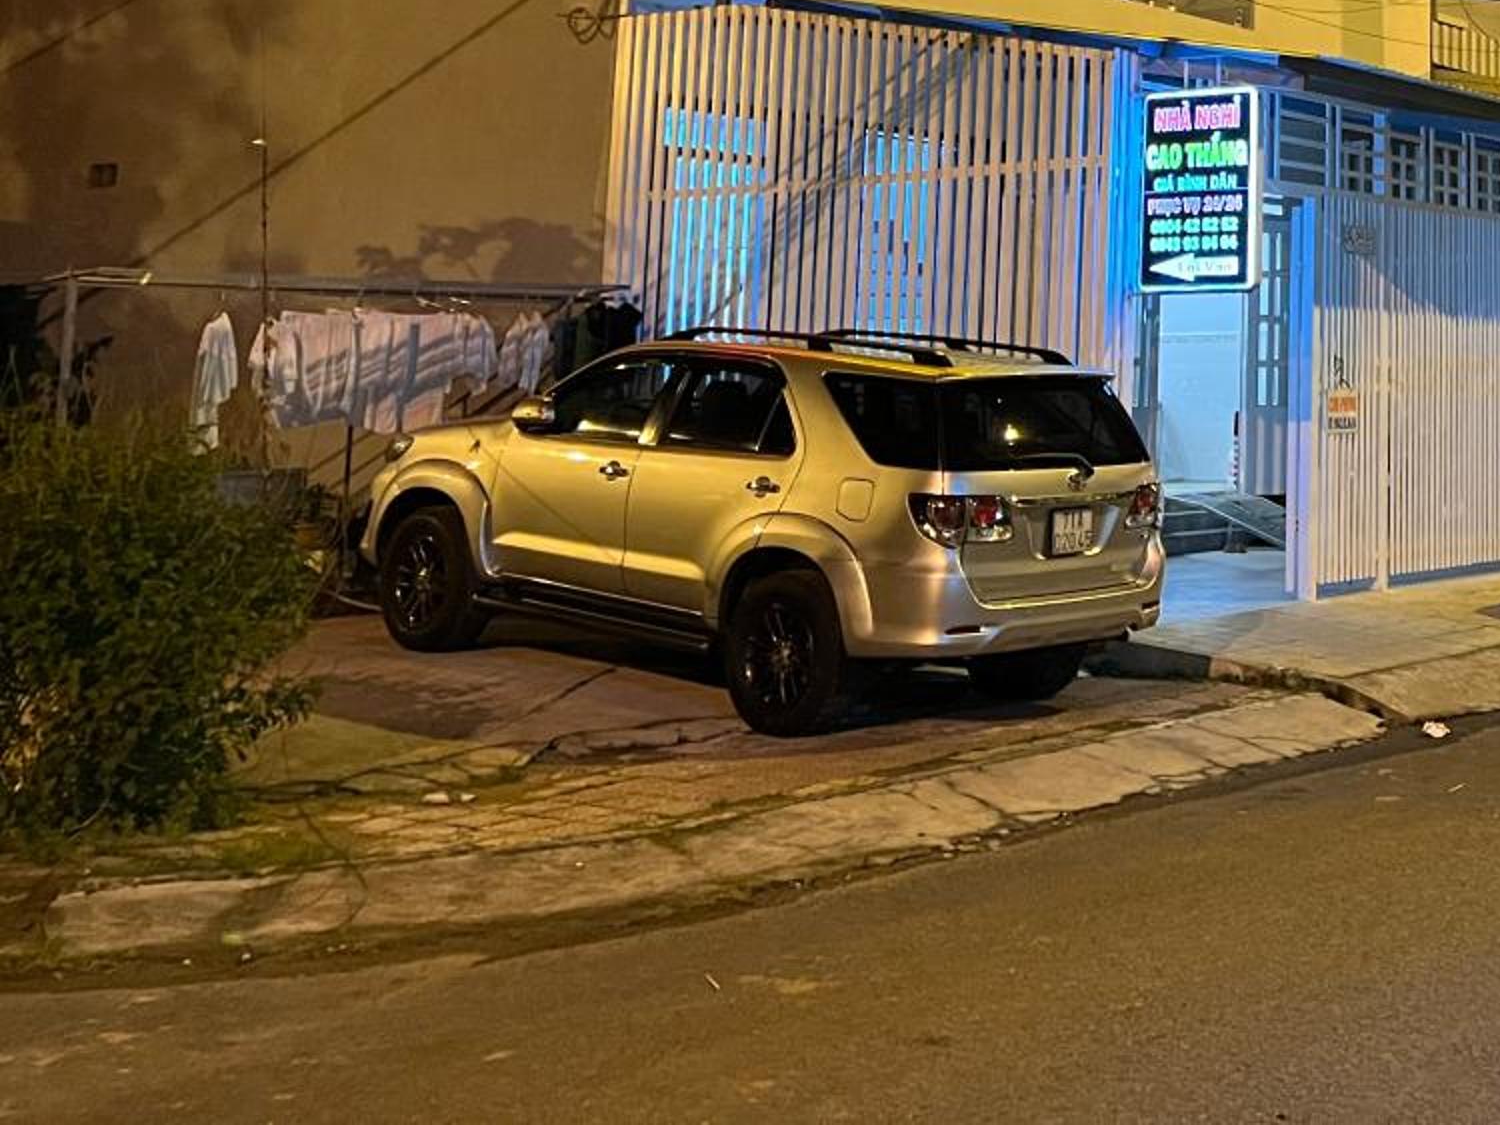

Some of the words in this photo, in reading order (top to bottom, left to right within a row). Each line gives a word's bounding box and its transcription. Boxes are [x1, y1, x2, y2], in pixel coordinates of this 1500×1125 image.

[1153, 100, 1192, 133] NHÀ
[1194, 94, 1241, 130] NGHỈ
[1146, 143, 1183, 171] CAO
